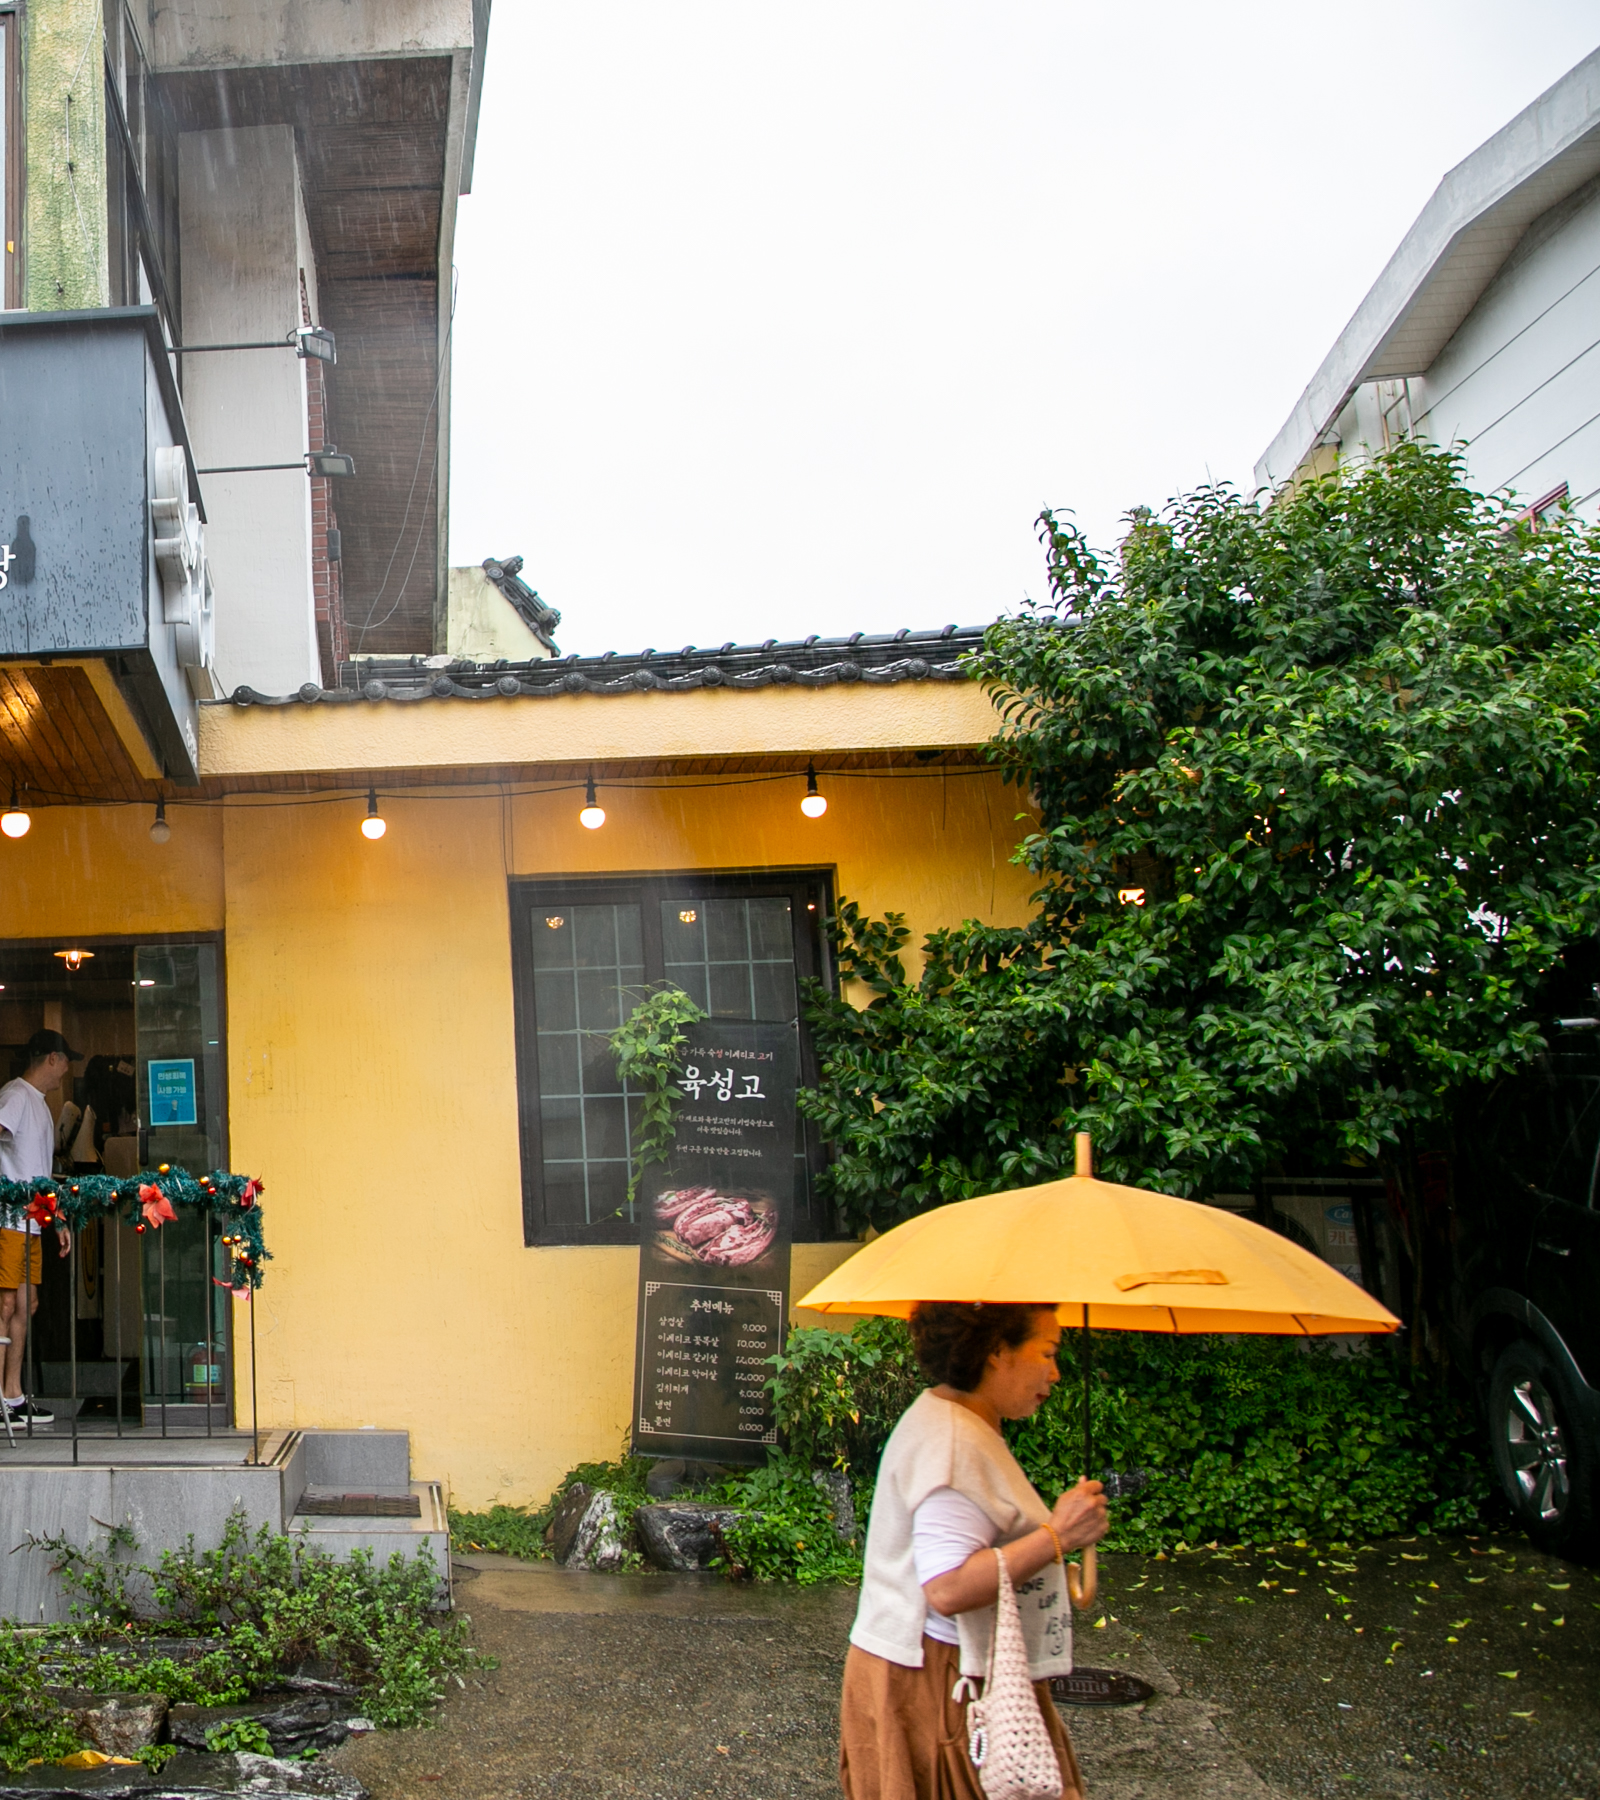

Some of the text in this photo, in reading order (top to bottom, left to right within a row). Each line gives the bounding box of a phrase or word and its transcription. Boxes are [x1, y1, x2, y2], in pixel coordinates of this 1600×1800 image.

[690, 1047, 706, 1057] 가득
[707, 1048, 723, 1059] 숙성
[725, 1049, 756, 1060] 이베리코
[757, 1051, 773, 1061] 고기
[677, 1064, 766, 1102] 육성고
[690, 1299, 734, 1314] 추천메뉴
[659, 1316, 767, 1333] 삼겹살 9,000
[658, 1333, 691, 1344] 이베리코
[737, 1339, 766, 1349] 10,000
[657, 1349, 766, 1366] 이베리코 갈비살 12,000
[656, 1366, 765, 1382] 이베리코 악어살 12,000
[655, 1383, 689, 1395] 김치찌개
[655, 1399, 764, 1416] 냉면 6,000
[738, 1423, 763, 1432] 6,000
